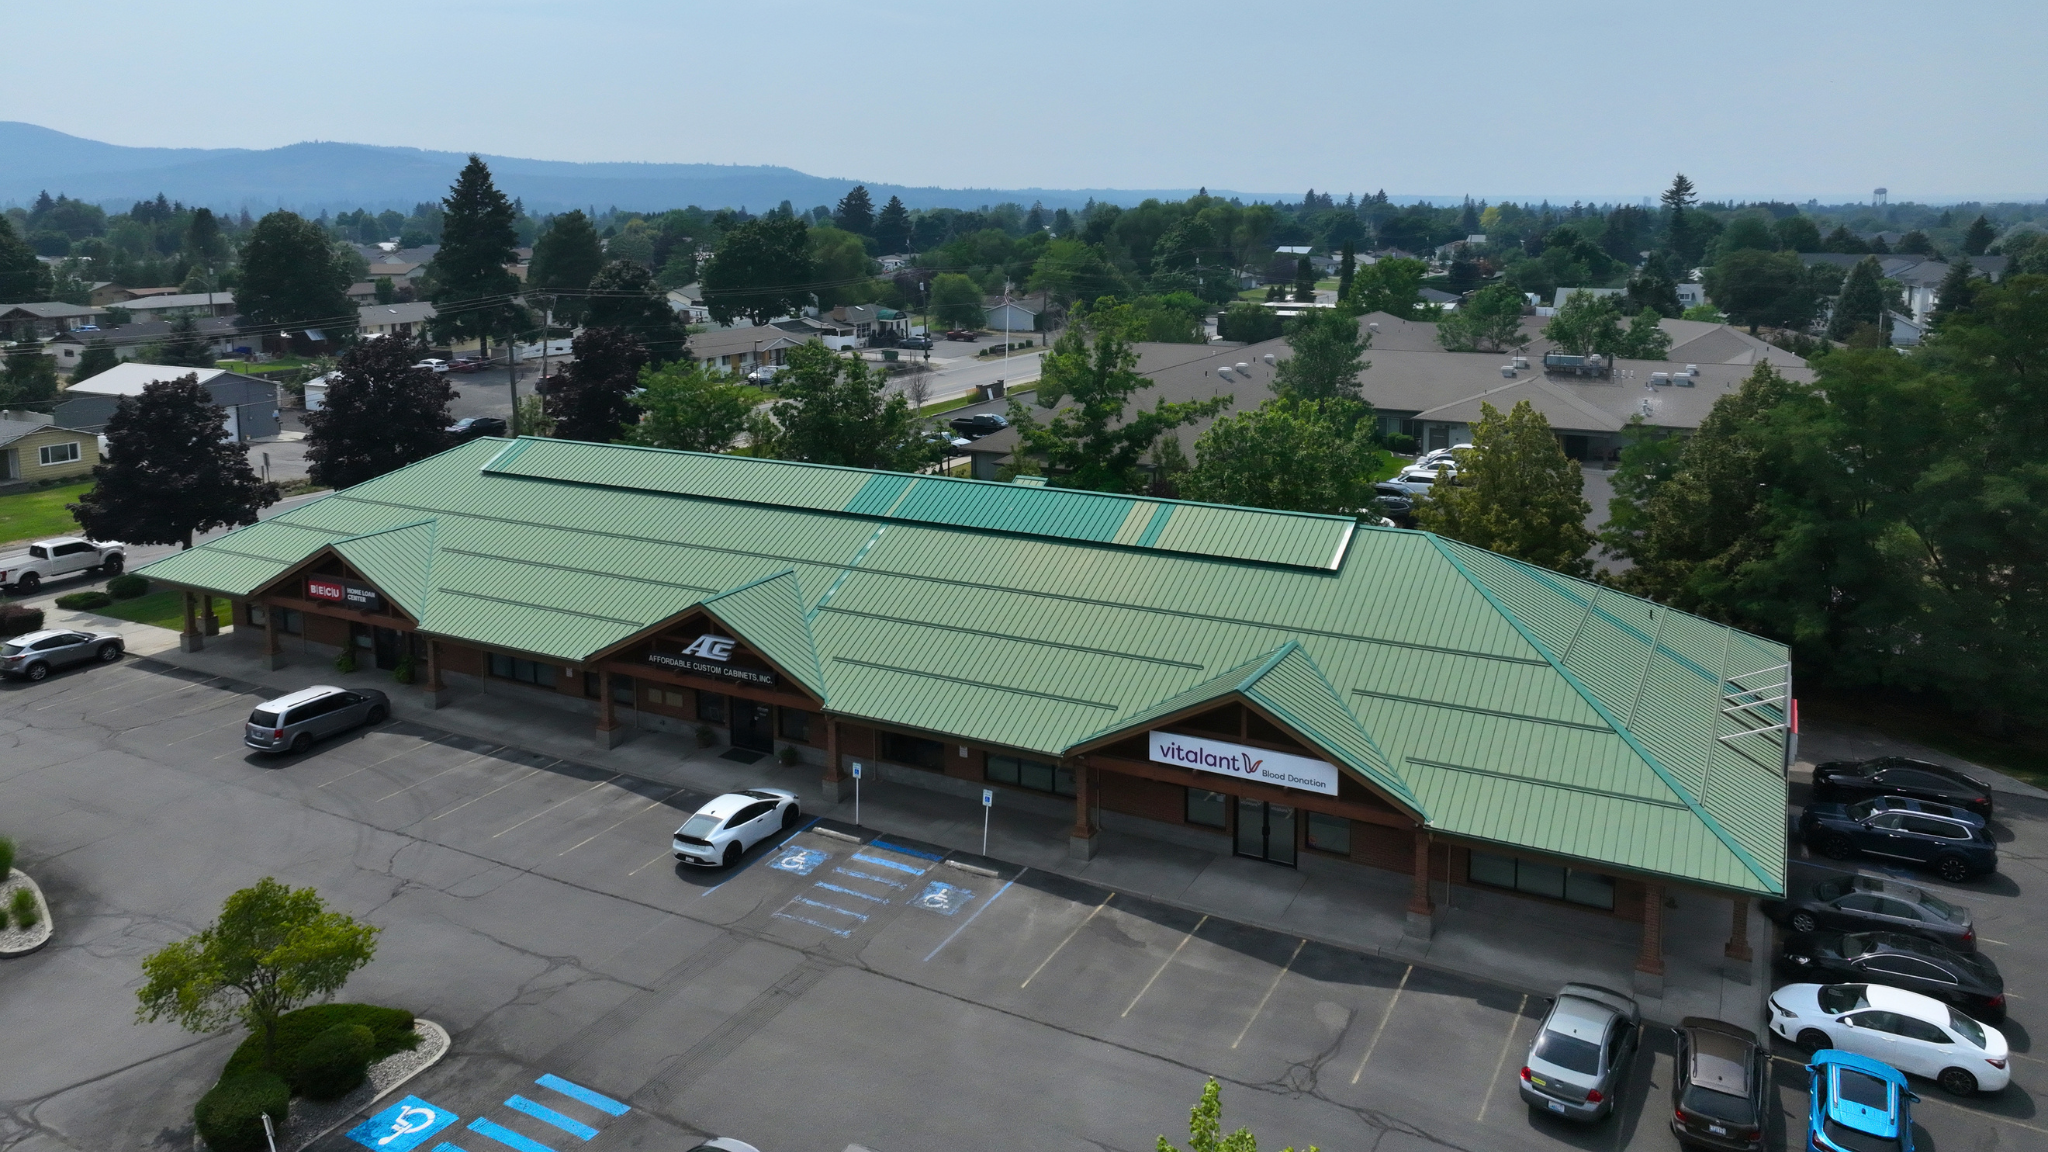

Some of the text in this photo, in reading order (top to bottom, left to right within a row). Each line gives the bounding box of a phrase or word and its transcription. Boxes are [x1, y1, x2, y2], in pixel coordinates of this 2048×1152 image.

[347, 587, 376, 598] HOME LOAN
[347, 594, 367, 603] CENTER
[648, 654, 692, 669] AFFORDABLE
[693, 662, 721, 675] CUSTOM
[759, 674, 773, 685] INC.
[1159, 742, 1240, 772] vitalant
[1262, 769, 1327, 789] Blood Donation
